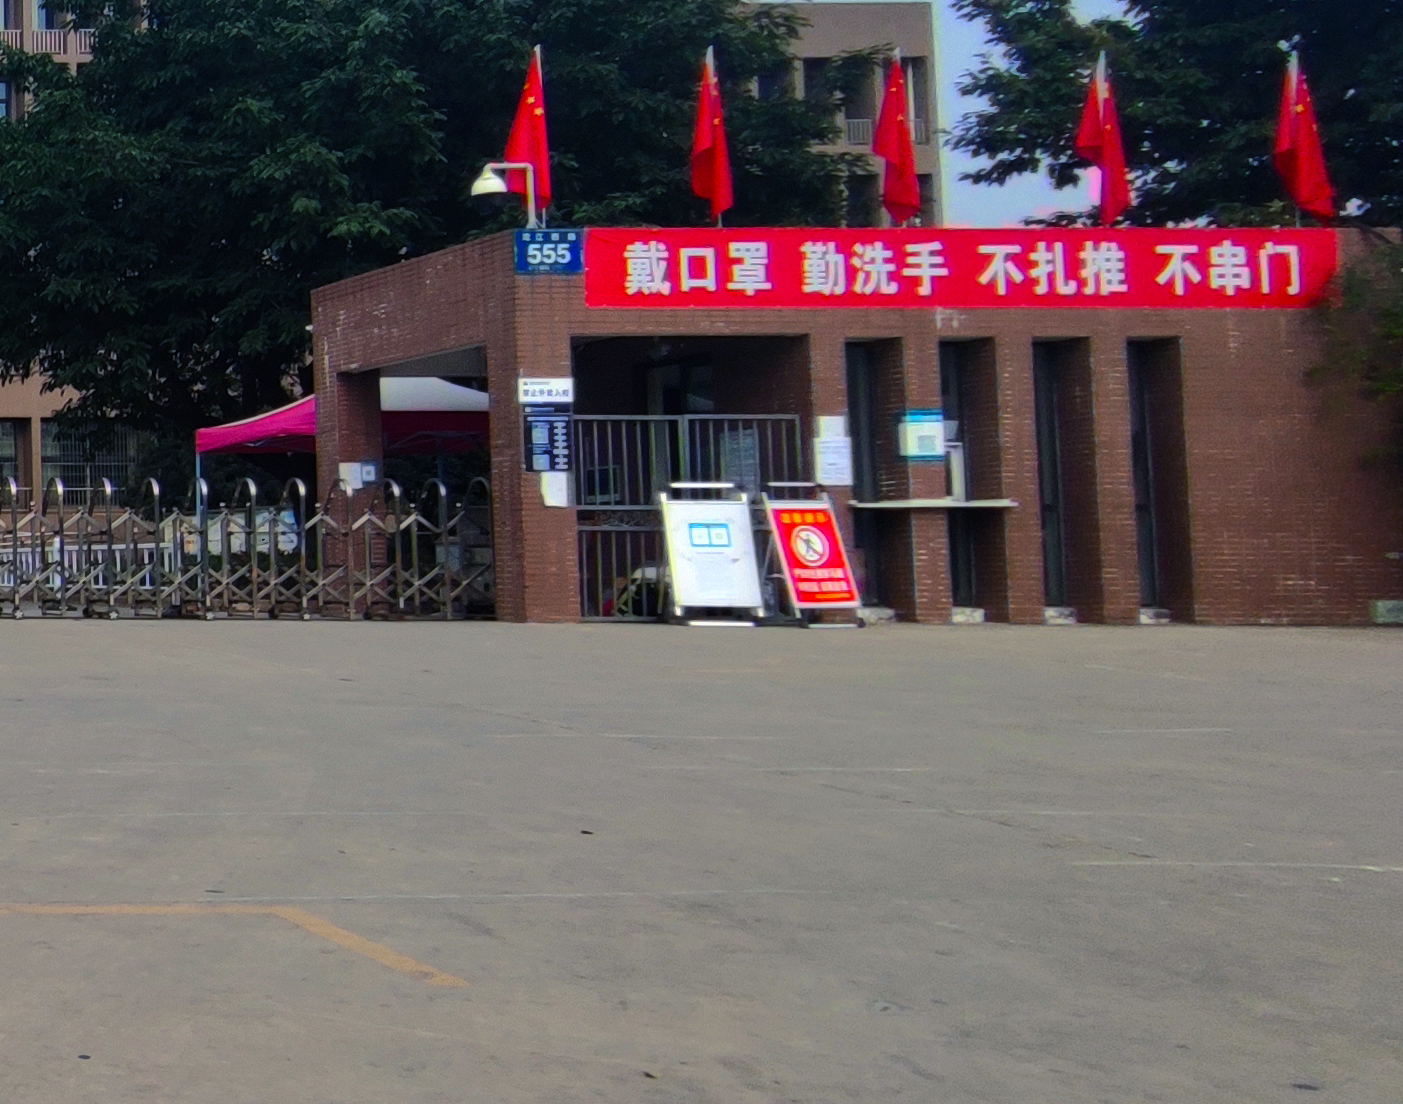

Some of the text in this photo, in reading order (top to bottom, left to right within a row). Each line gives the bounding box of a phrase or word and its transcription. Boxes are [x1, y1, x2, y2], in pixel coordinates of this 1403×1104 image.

[527, 243, 572, 264] 555
[623, 240, 1302, 298] 戴口罩 勤洗手 不扎推 不串门
